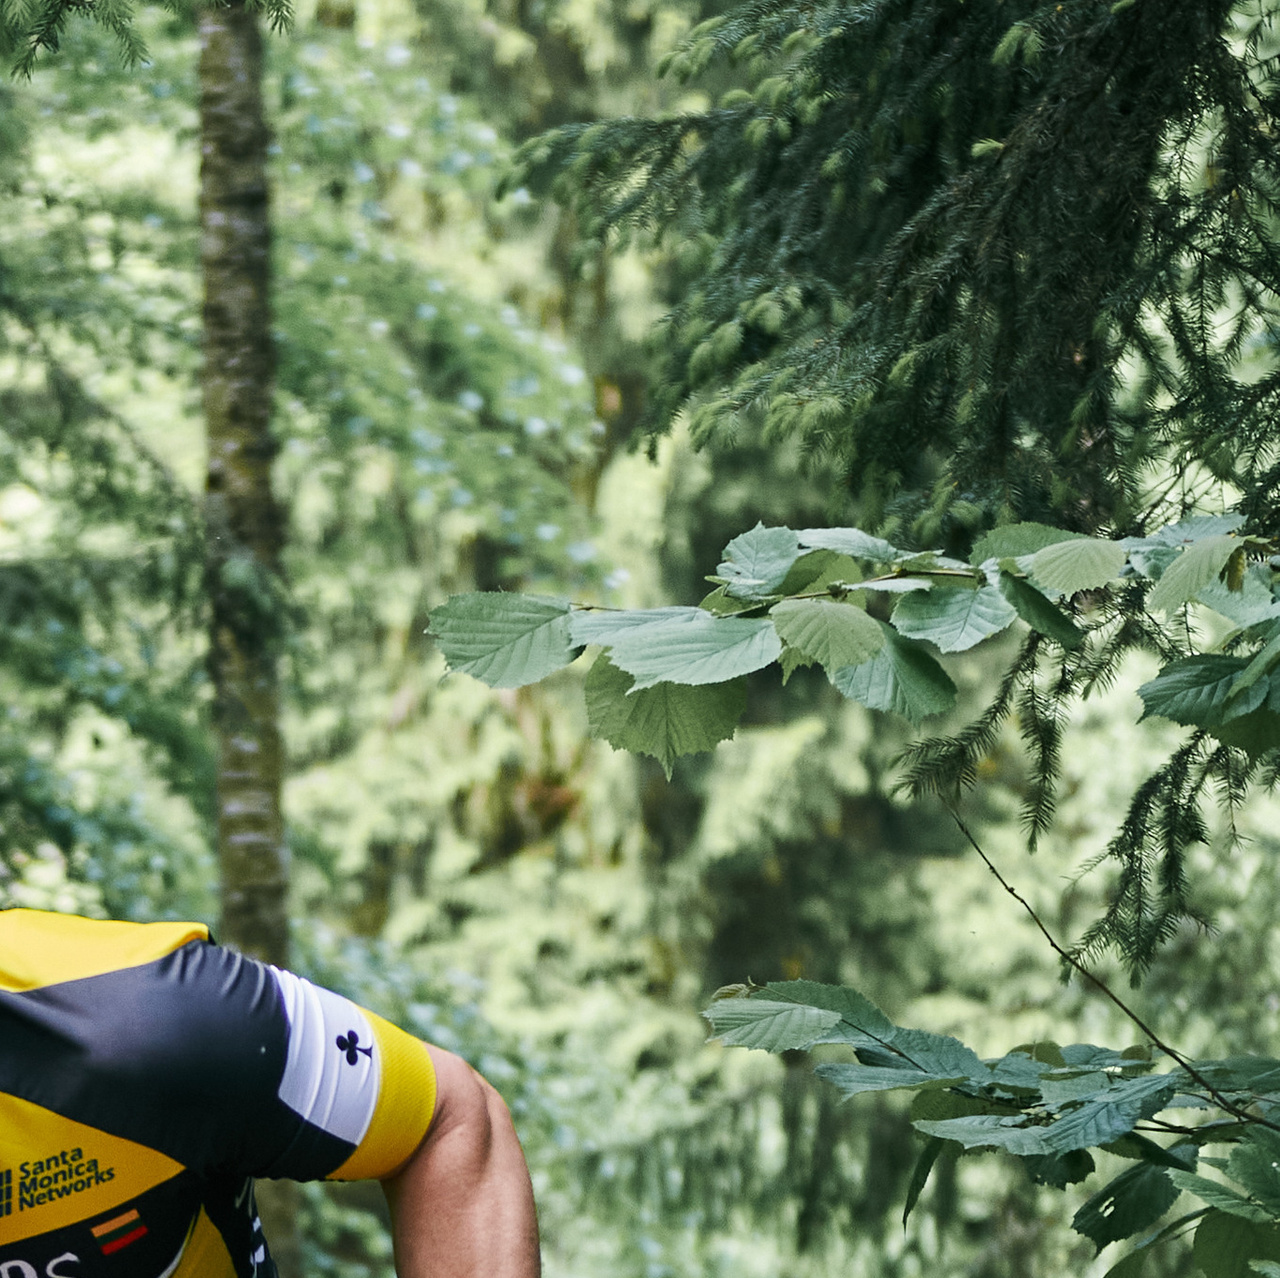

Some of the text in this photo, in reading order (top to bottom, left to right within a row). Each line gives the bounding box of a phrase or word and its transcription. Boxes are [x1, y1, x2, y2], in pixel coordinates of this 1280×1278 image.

[20, 1148, 83, 1180] Santa
[20, 1159, 99, 1196] Monica
[20, 1167, 115, 1211] Networks
